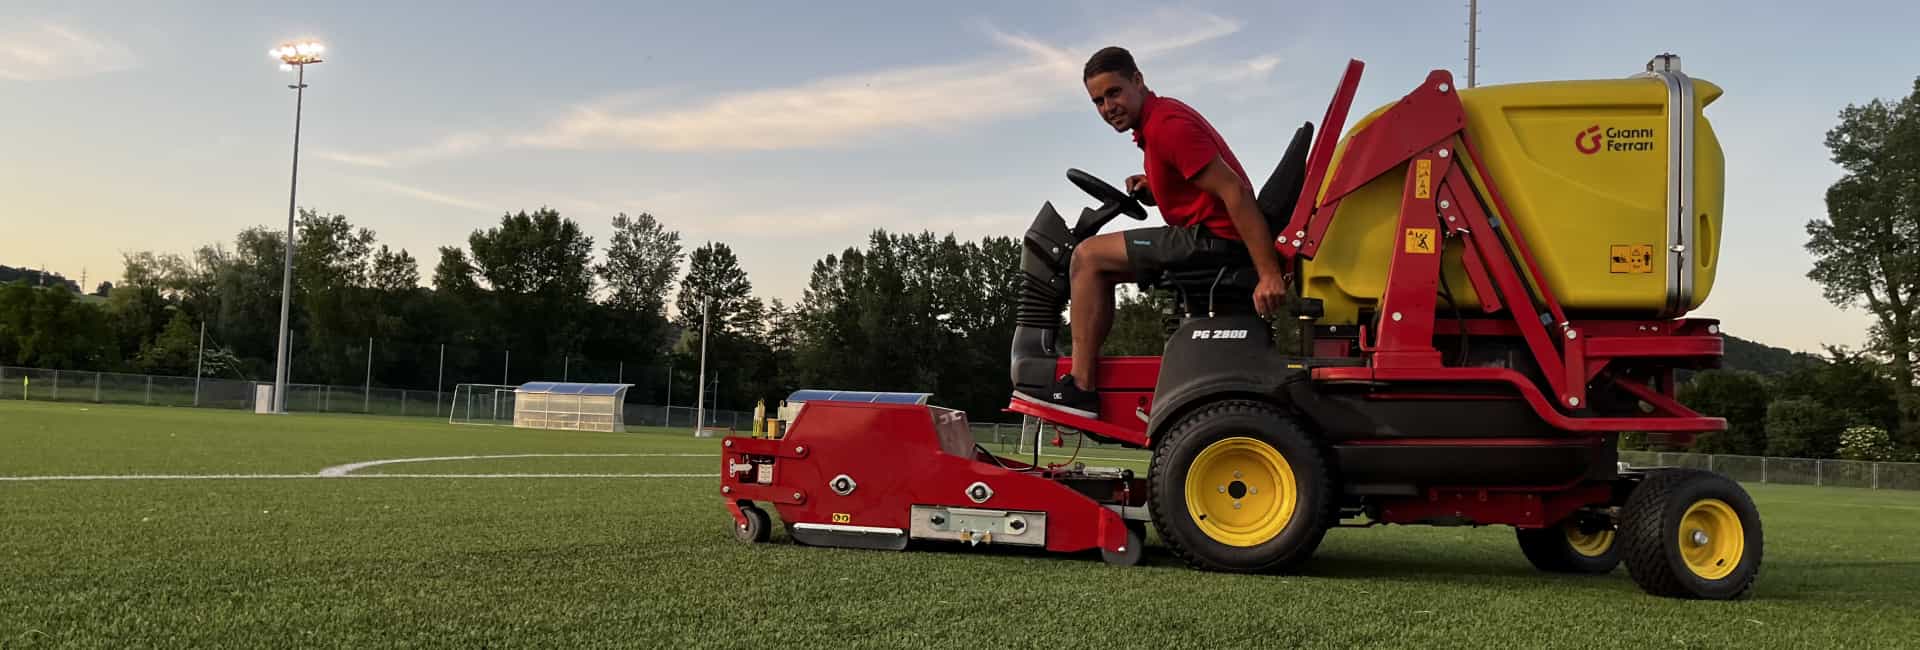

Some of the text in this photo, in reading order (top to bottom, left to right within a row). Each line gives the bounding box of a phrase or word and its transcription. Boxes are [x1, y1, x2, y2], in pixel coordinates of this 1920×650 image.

[1606, 127, 1653, 138] Gianni
[1607, 140, 1653, 151] Ferrari
[1192, 330, 1211, 339] PG
